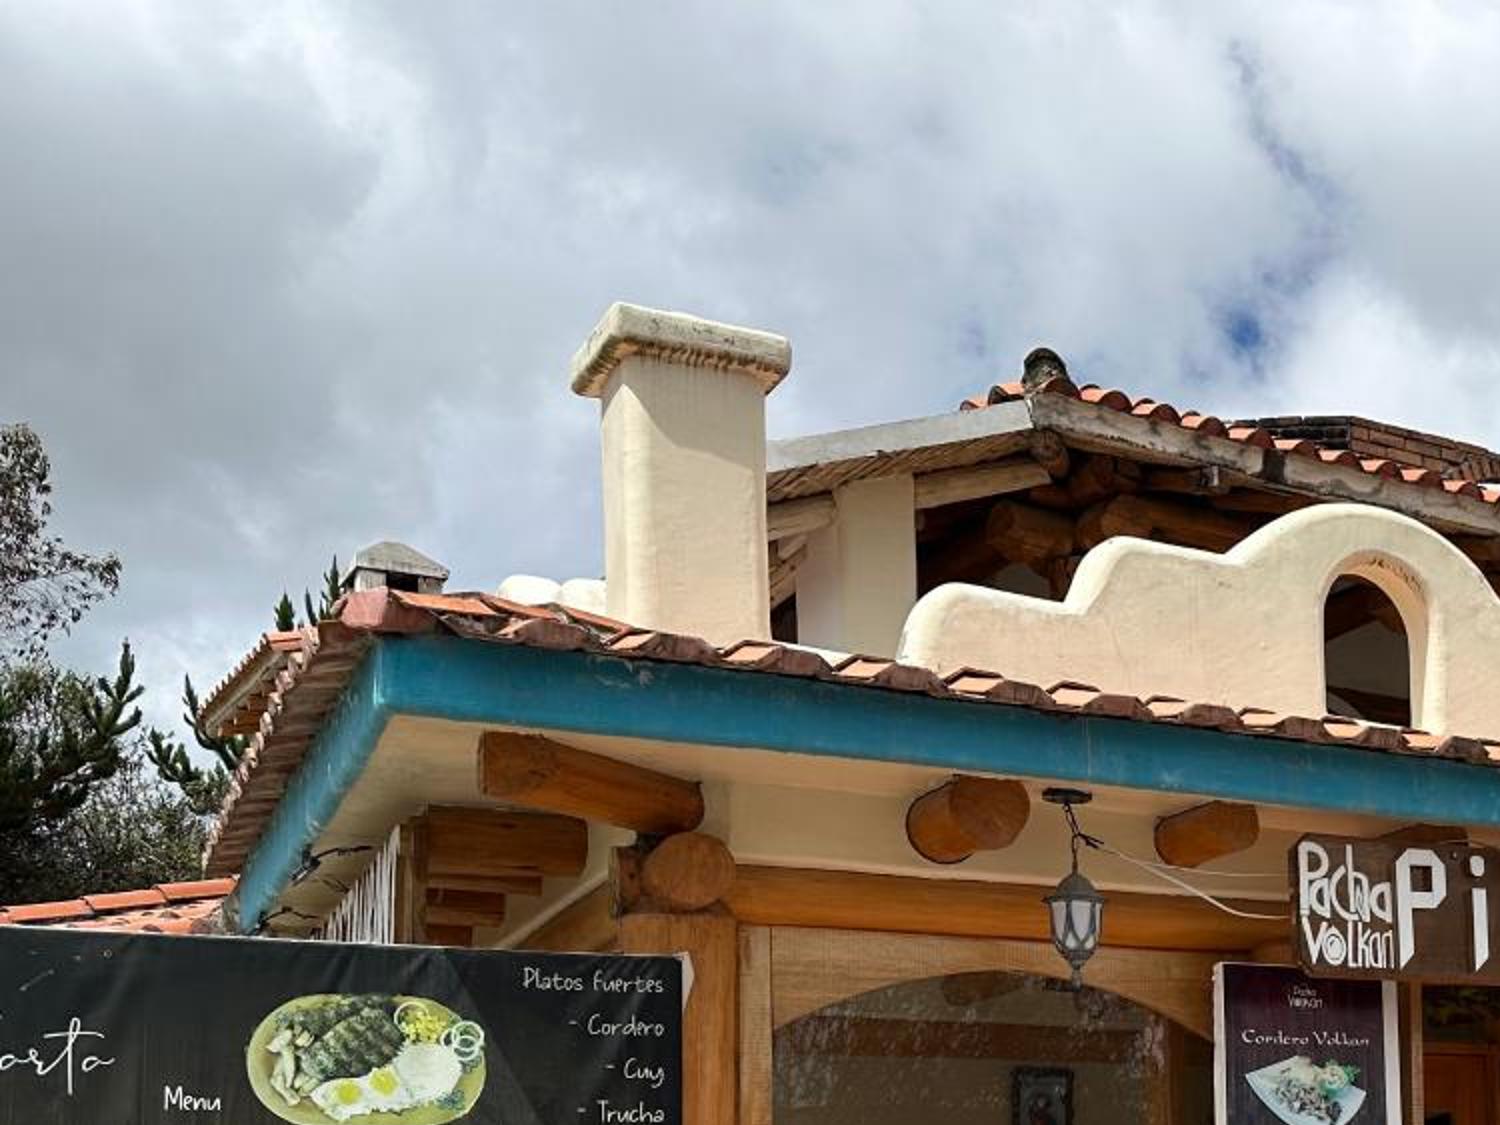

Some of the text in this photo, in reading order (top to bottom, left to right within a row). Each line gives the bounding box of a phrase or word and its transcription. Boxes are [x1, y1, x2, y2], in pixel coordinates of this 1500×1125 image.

[1298, 841, 1393, 923] Pacha
[1301, 914, 1395, 969] Volkan
[523, 967, 664, 994] Platos fuertes
[587, 1013, 665, 1037] Cordero
[1241, 1028, 1371, 1047] Cordero Volkan
[0, 1017, 116, 1096] arta
[623, 1057, 665, 1088] Cuy
[164, 1085, 222, 1112] Menu
[597, 1100, 665, 1124] Trucha
